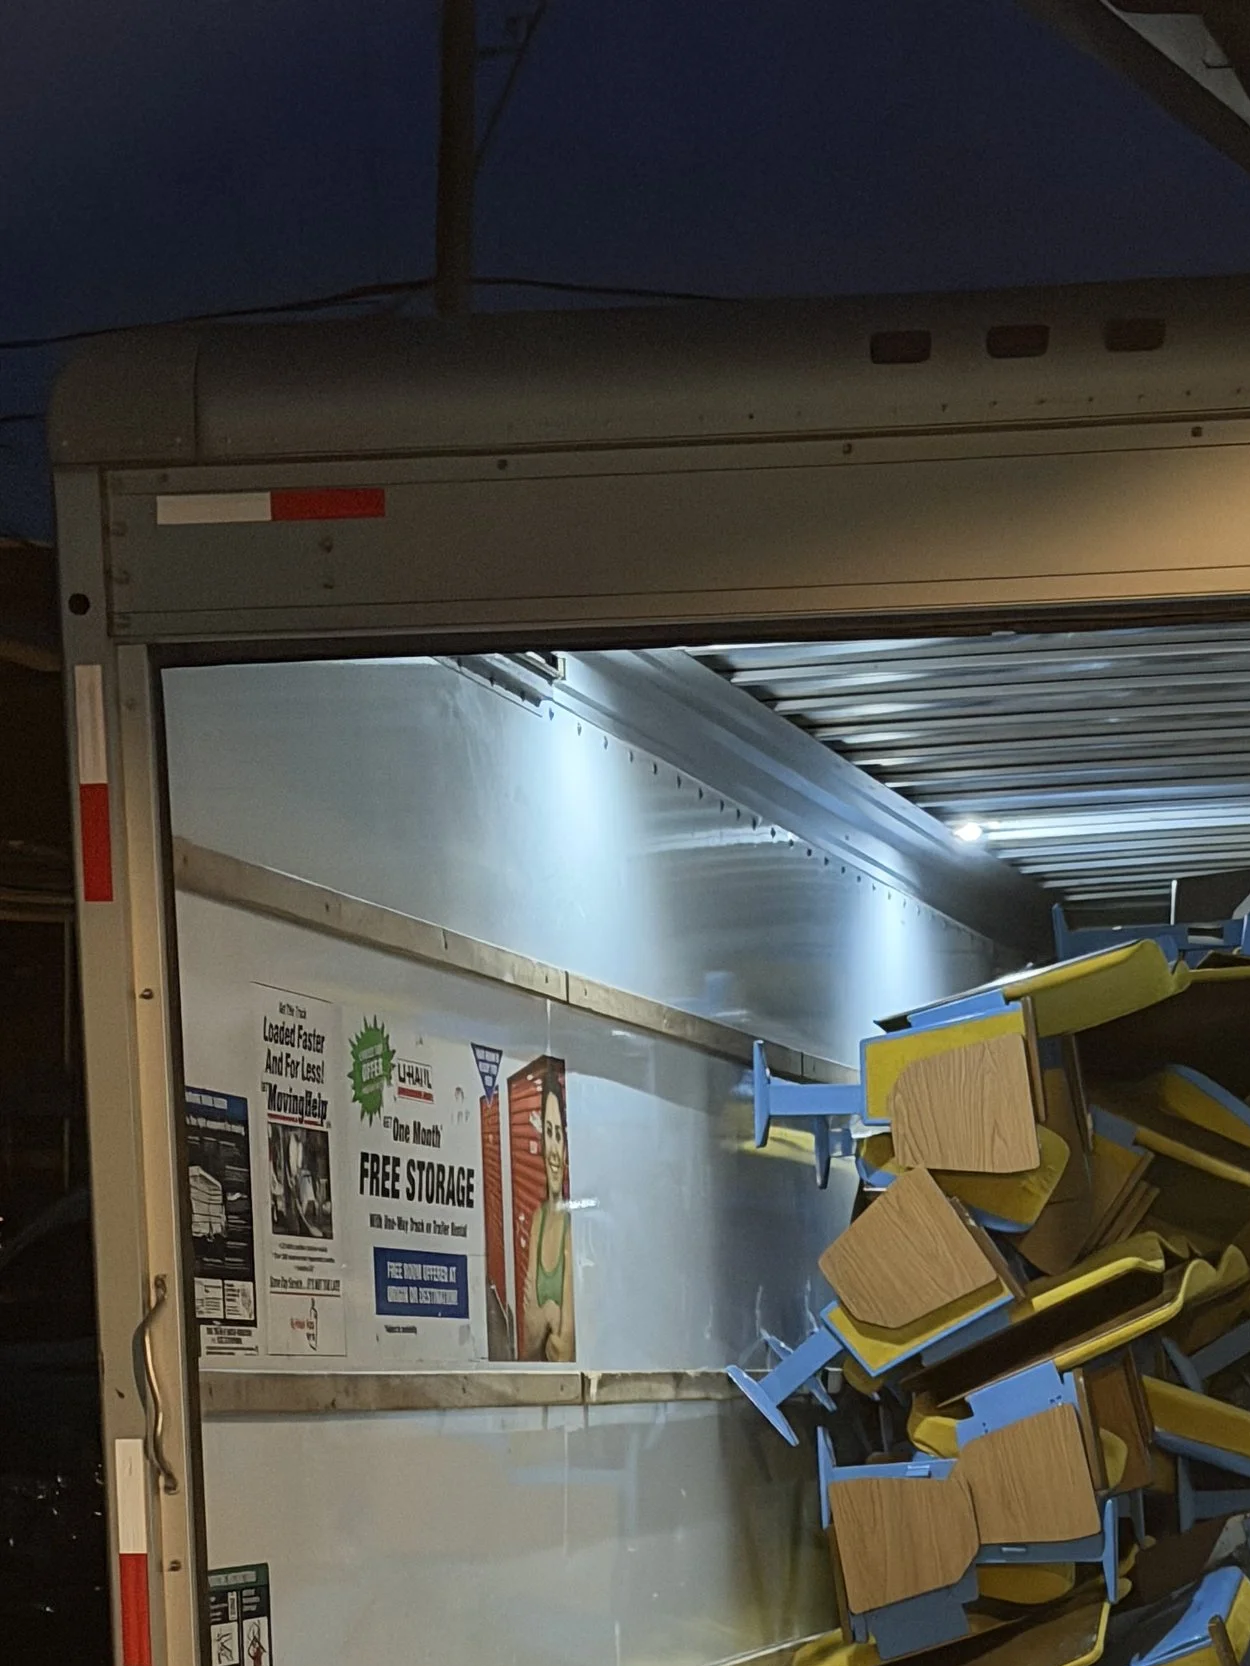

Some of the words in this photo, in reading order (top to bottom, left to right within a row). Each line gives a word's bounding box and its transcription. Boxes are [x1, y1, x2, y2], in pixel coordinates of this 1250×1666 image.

[263, 1015, 295, 1048] Loaded
[297, 1024, 325, 1054] Faster
[265, 1047, 283, 1076] And
[285, 1052, 300, 1079] For
[301, 1055, 325, 1084] Less!
[392, 1116, 410, 1143] One
[360, 1151, 400, 1199] FREE
[406, 1158, 474, 1208] STORAGE
